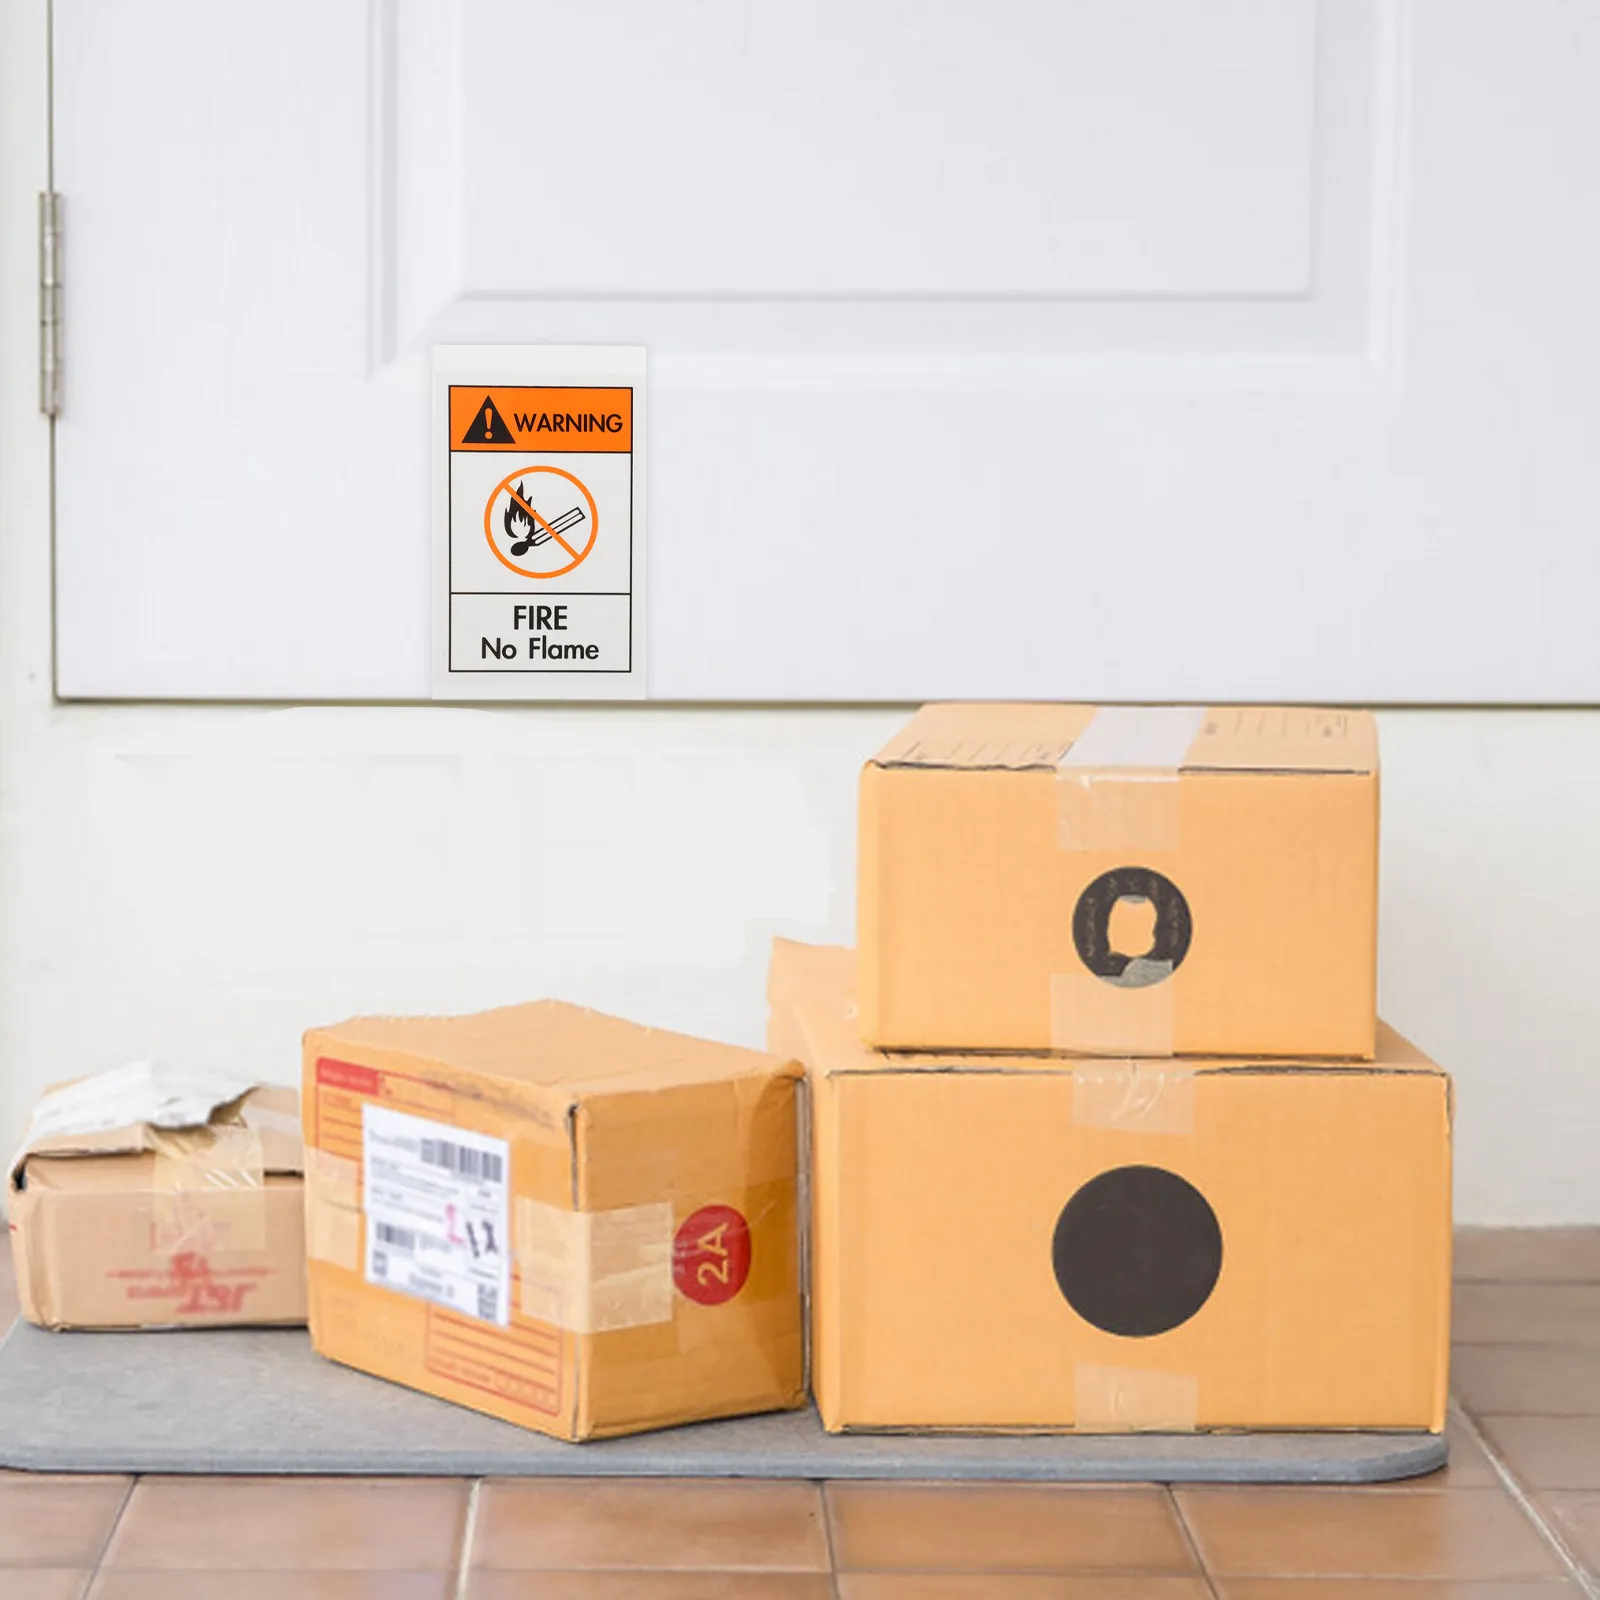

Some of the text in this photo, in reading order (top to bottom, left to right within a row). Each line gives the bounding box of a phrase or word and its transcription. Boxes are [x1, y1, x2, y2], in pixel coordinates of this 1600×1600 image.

[514, 413, 623, 433] WARNING
[513, 605, 568, 630] FIRE
[481, 635, 600, 660] No Flame
[697, 1222, 729, 1287] 2A
